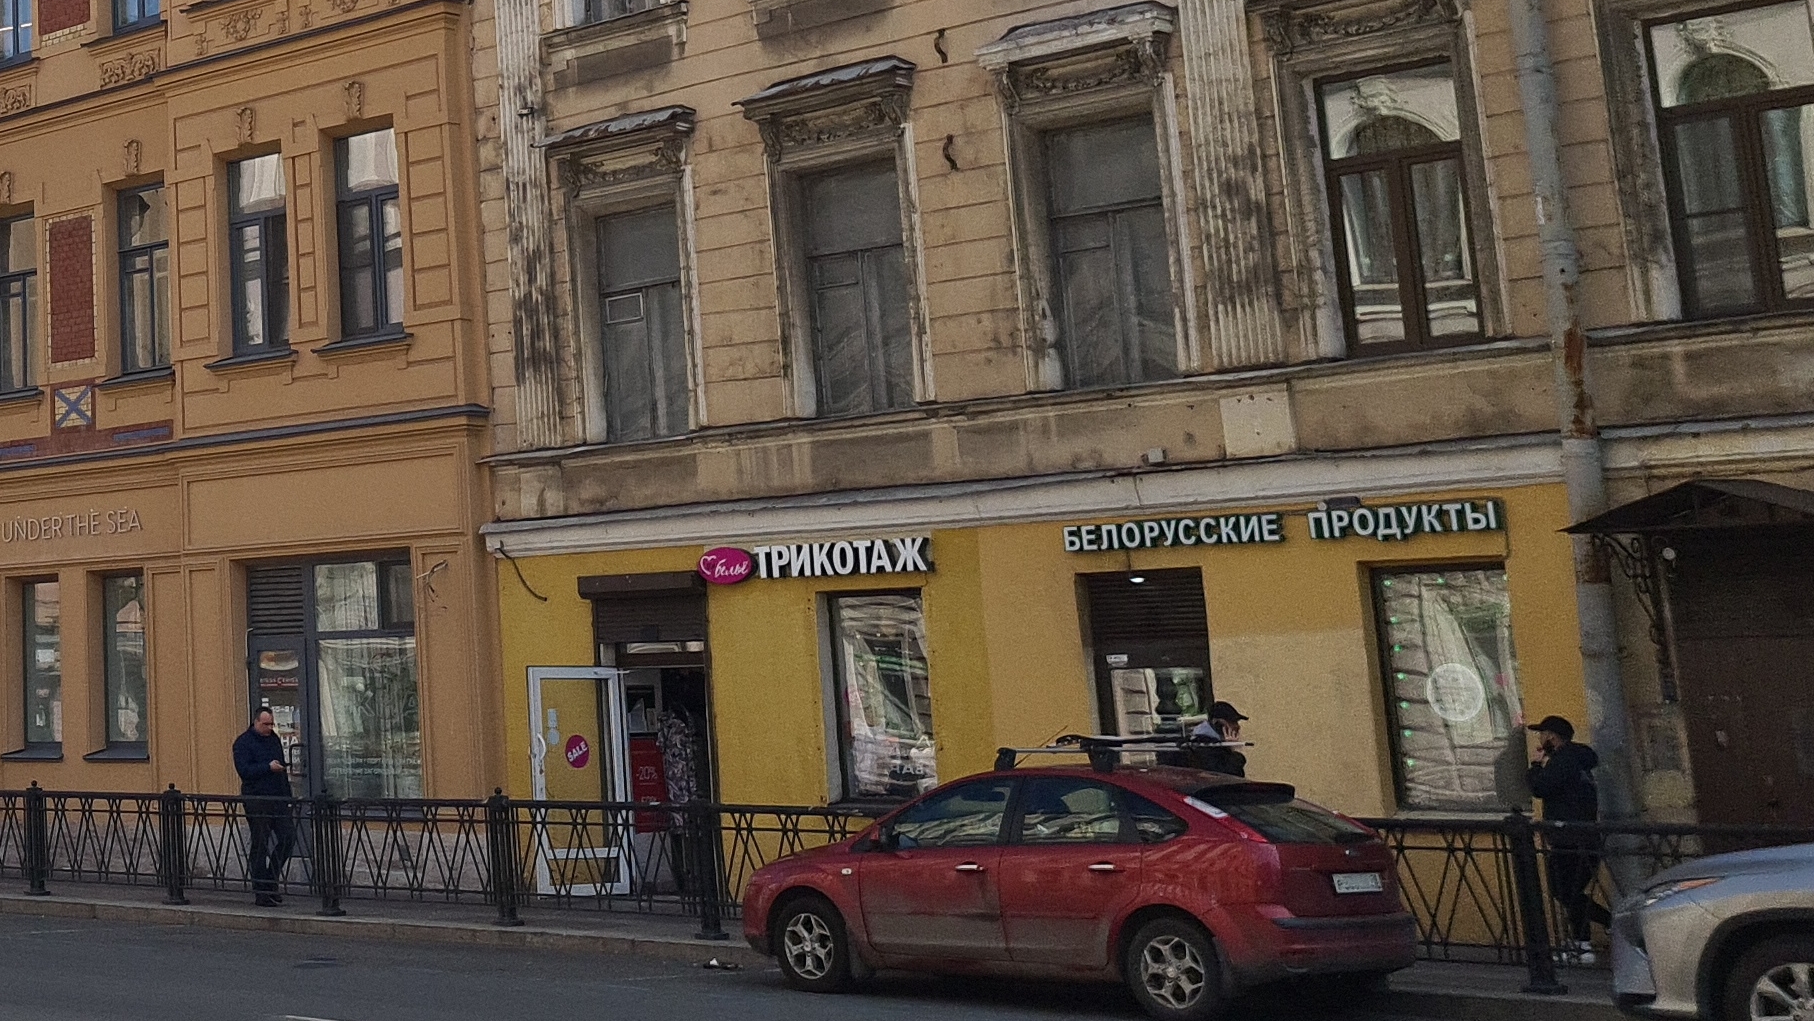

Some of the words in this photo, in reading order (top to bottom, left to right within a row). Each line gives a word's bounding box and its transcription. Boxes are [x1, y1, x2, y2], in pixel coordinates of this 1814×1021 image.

[1, 516, 63, 543] UNDER
[65, 511, 101, 537] THE
[106, 509, 143, 535] SEA
[1062, 513, 1281, 552] БЕЛОРУССКИЕ
[1307, 501, 1498, 541] ПРОДУКТЫ
[753, 536, 928, 579] ТРИКОТАЖ
[567, 741, 589, 762] SALE
